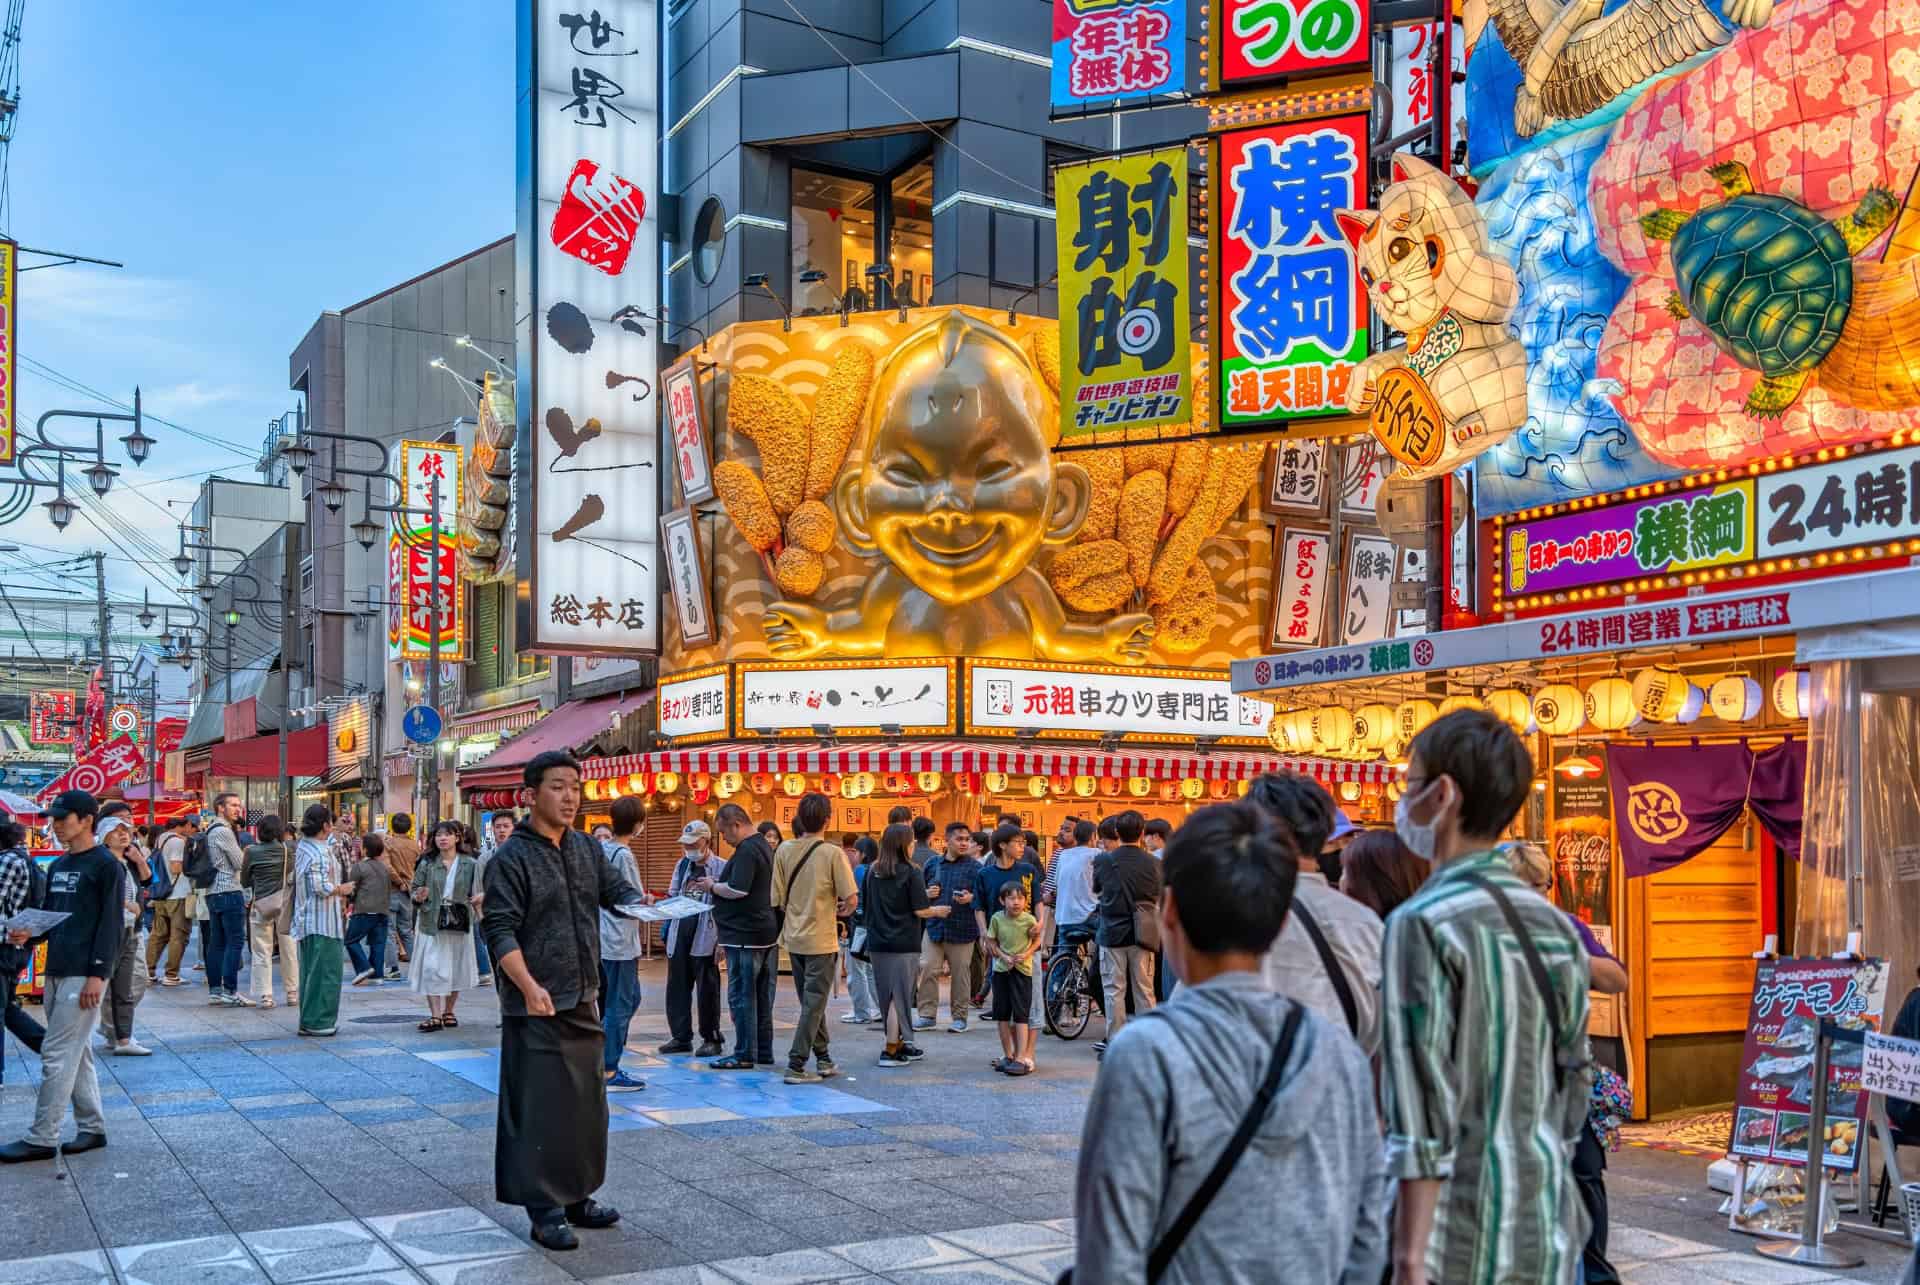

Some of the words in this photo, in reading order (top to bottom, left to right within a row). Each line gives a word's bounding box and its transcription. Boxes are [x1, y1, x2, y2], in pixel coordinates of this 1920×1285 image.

[1076, 13, 1164, 55] 年中
[1077, 51, 1164, 91] 無休
[1234, 133, 1355, 358] 横綱
[1072, 161, 1178, 377] 射的
[1077, 374, 1181, 402] 新世界遊技場
[1076, 394, 1182, 427] チャンピオン
[1767, 460, 1920, 546] 24時
[1528, 529, 1634, 572] 日本一の串かつ
[1634, 488, 1746, 570] 横綱
[411, 546, 452, 630] 王将
[1288, 538, 1319, 638] 紅しょうが
[550, 594, 645, 631] 総本店
[1541, 600, 1682, 653] 24時間営業
[1692, 597, 1784, 630] 年中無休
[1273, 654, 1365, 681] 日本一の串かつ
[1368, 641, 1411, 672] 横綱
[661, 690, 724, 722] 串カツ専門店
[1023, 683, 1230, 722] 元祖串カツ専門店
